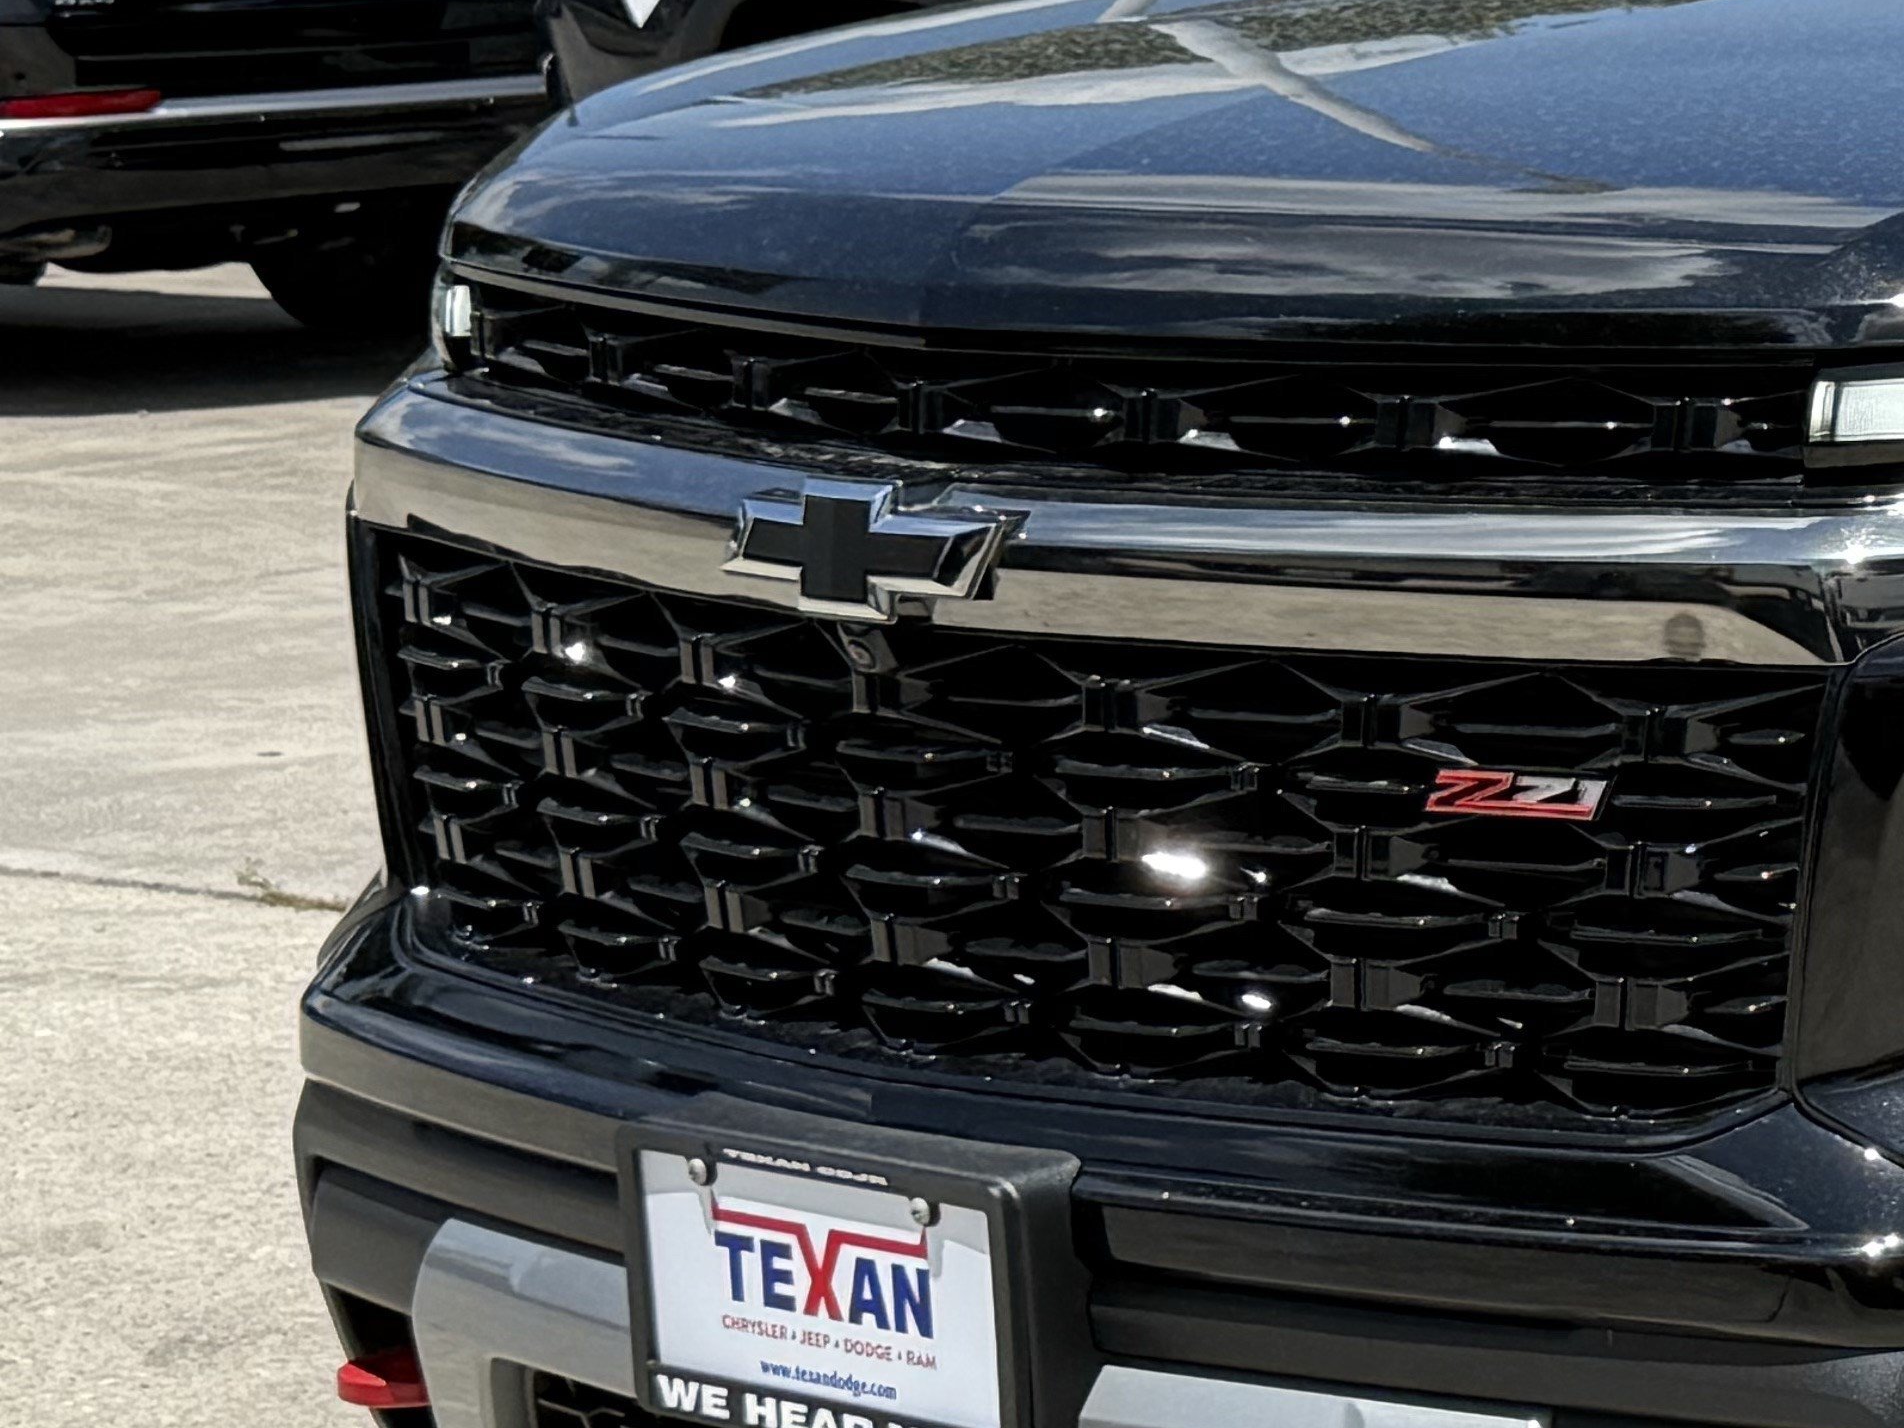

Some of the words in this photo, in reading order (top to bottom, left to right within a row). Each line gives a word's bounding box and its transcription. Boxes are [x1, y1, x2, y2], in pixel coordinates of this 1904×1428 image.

[1424, 768, 1609, 821] Z71
[713, 1220, 935, 1340] TEXAN
[721, 1313, 788, 1341] CHRYSLER
[799, 1330, 831, 1349] JEEP
[843, 1337, 893, 1362] DODGE
[905, 1349, 938, 1371] RAM
[655, 1373, 730, 1420] WE
[760, 1359, 898, 1401] www.texandodge.com
